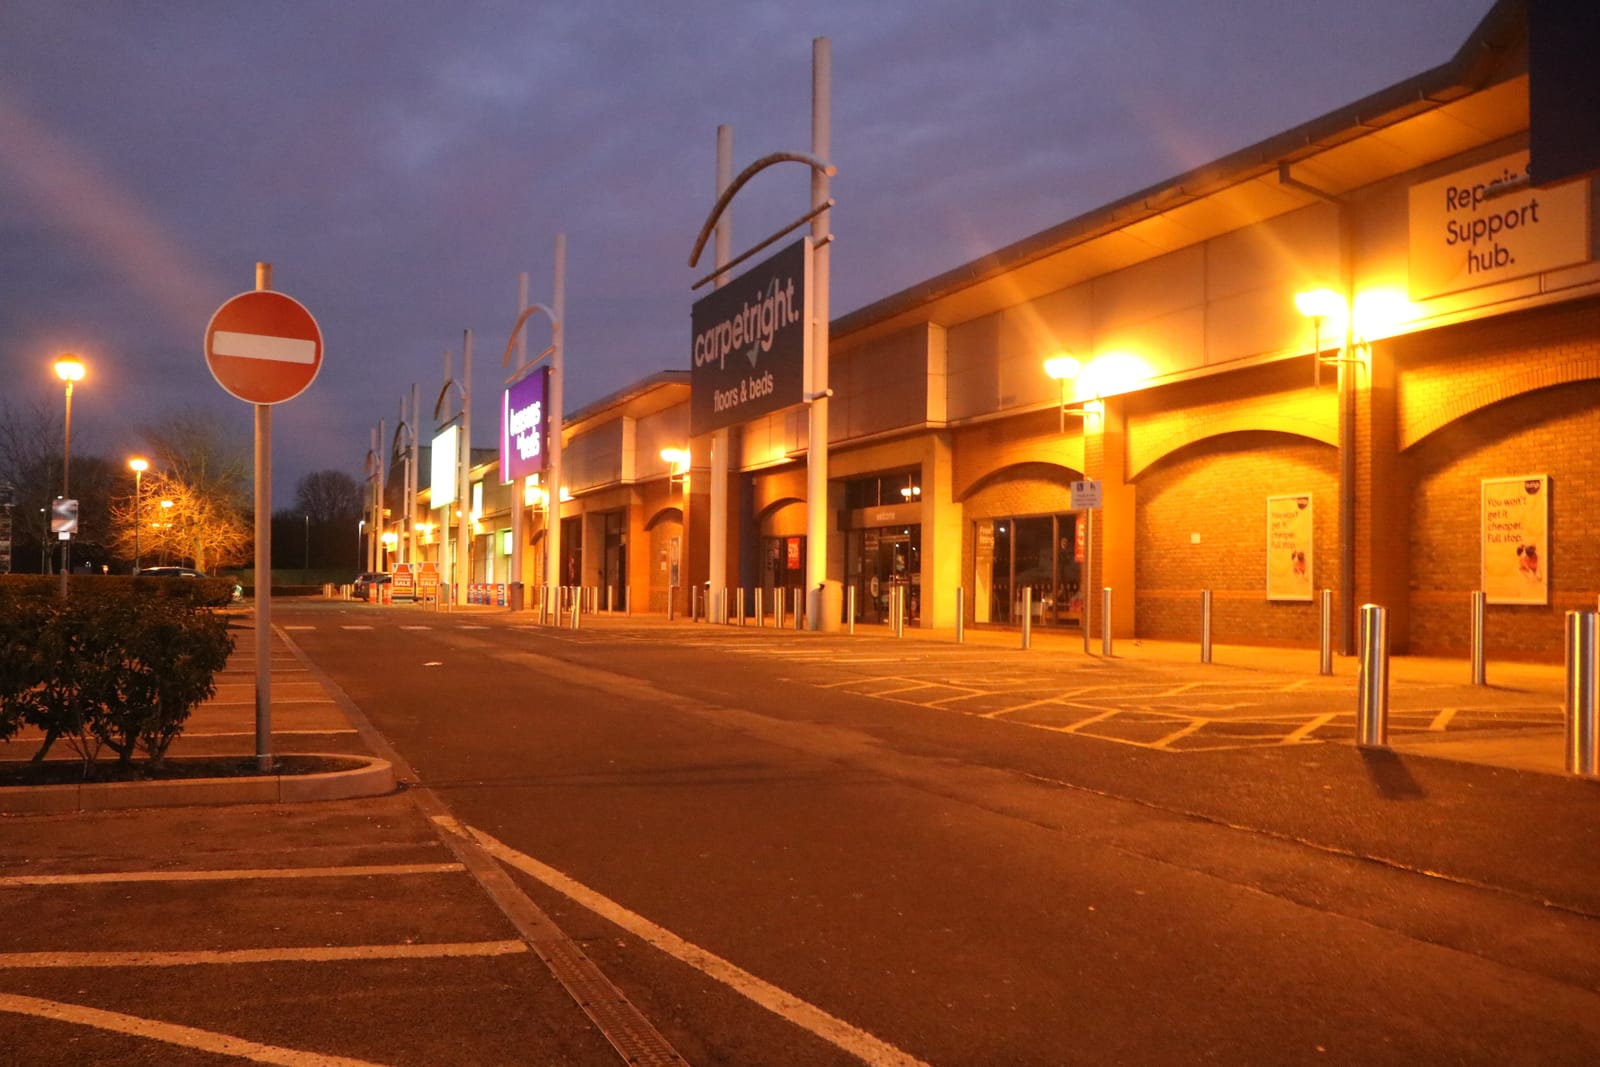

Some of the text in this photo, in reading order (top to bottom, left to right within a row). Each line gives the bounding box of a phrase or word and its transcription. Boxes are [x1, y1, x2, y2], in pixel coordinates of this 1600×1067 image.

[1446, 169, 1518, 212] Rep
[1446, 198, 1539, 246] Support
[1468, 243, 1515, 275] hub.
[695, 278, 799, 370] carpetright.
[714, 370, 774, 413] floors & beds
